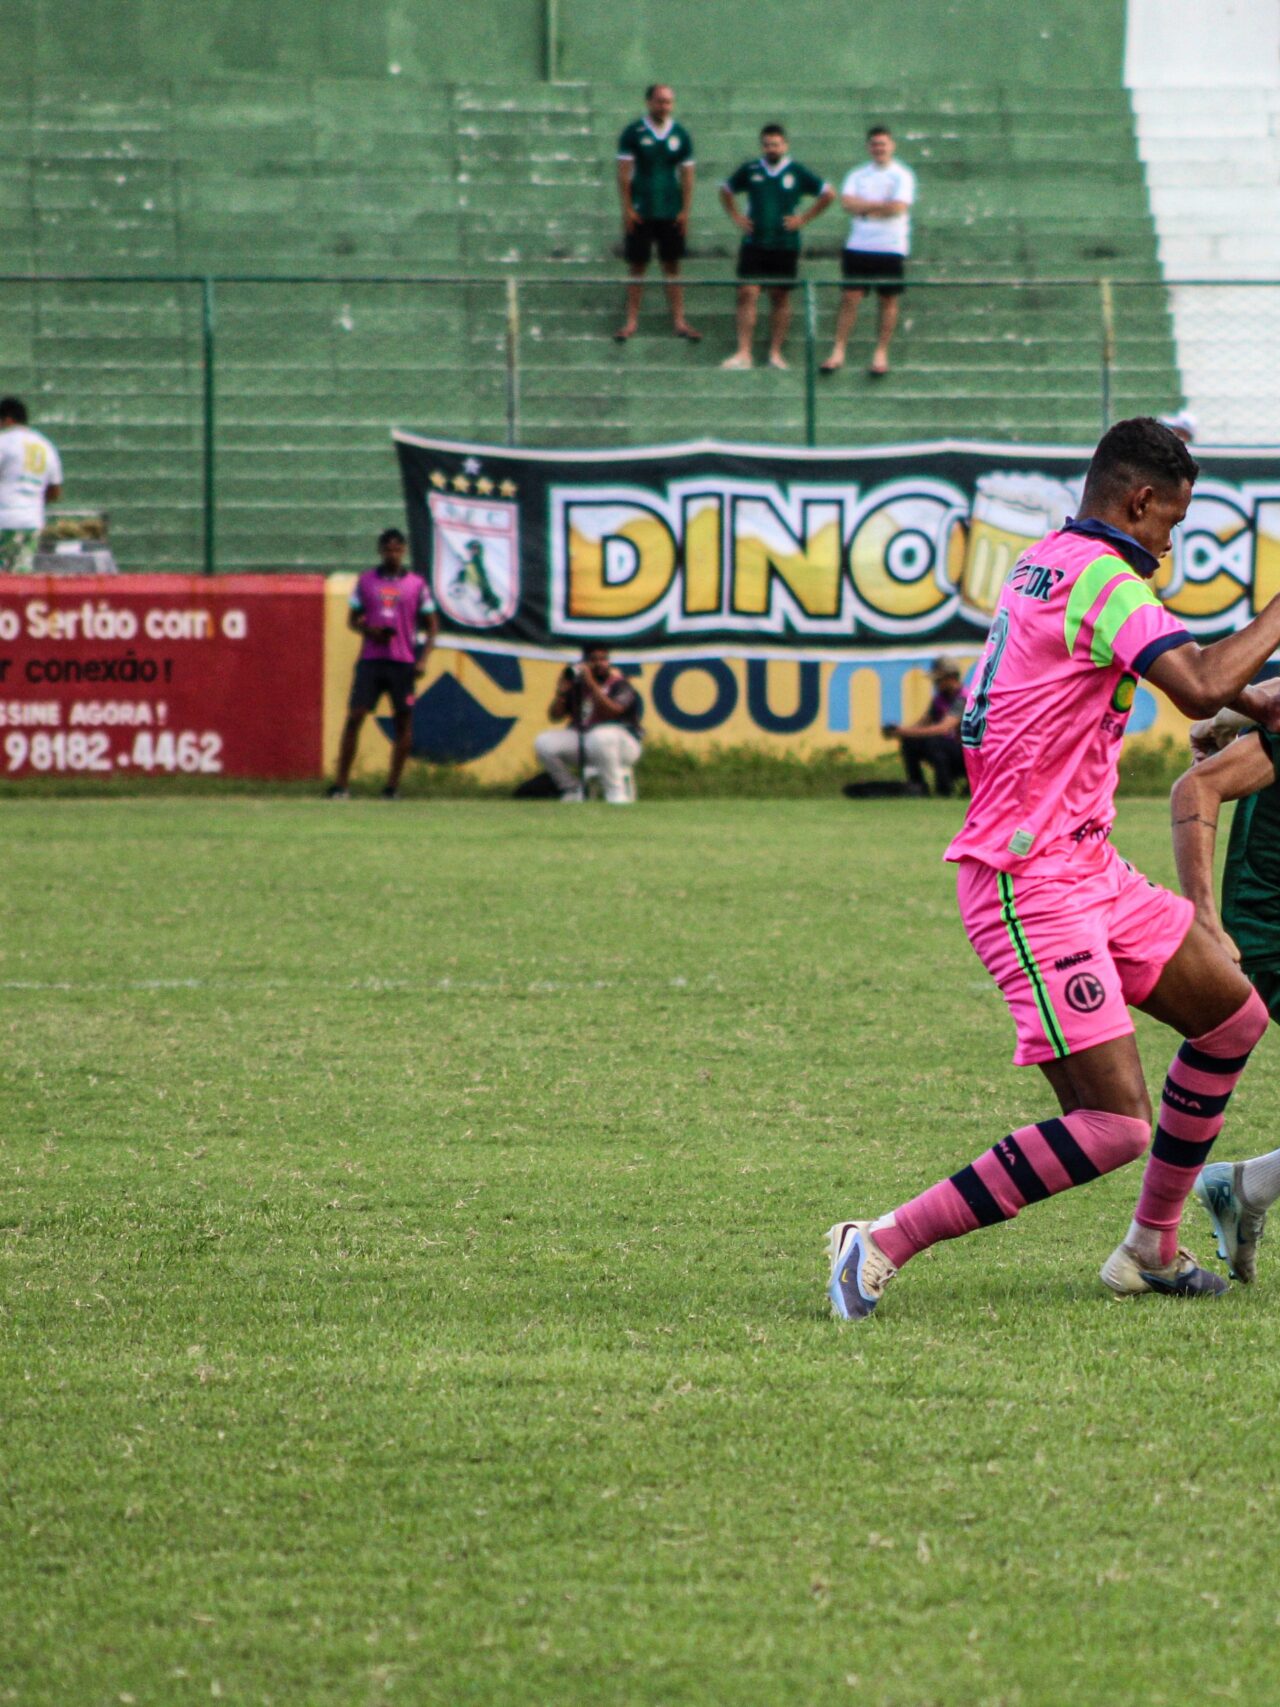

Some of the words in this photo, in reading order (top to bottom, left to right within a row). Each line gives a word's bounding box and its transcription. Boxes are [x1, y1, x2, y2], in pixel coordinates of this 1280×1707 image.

[549, 478, 968, 637] DINO
[26, 600, 138, 640] Sertão
[222, 609, 247, 640] a
